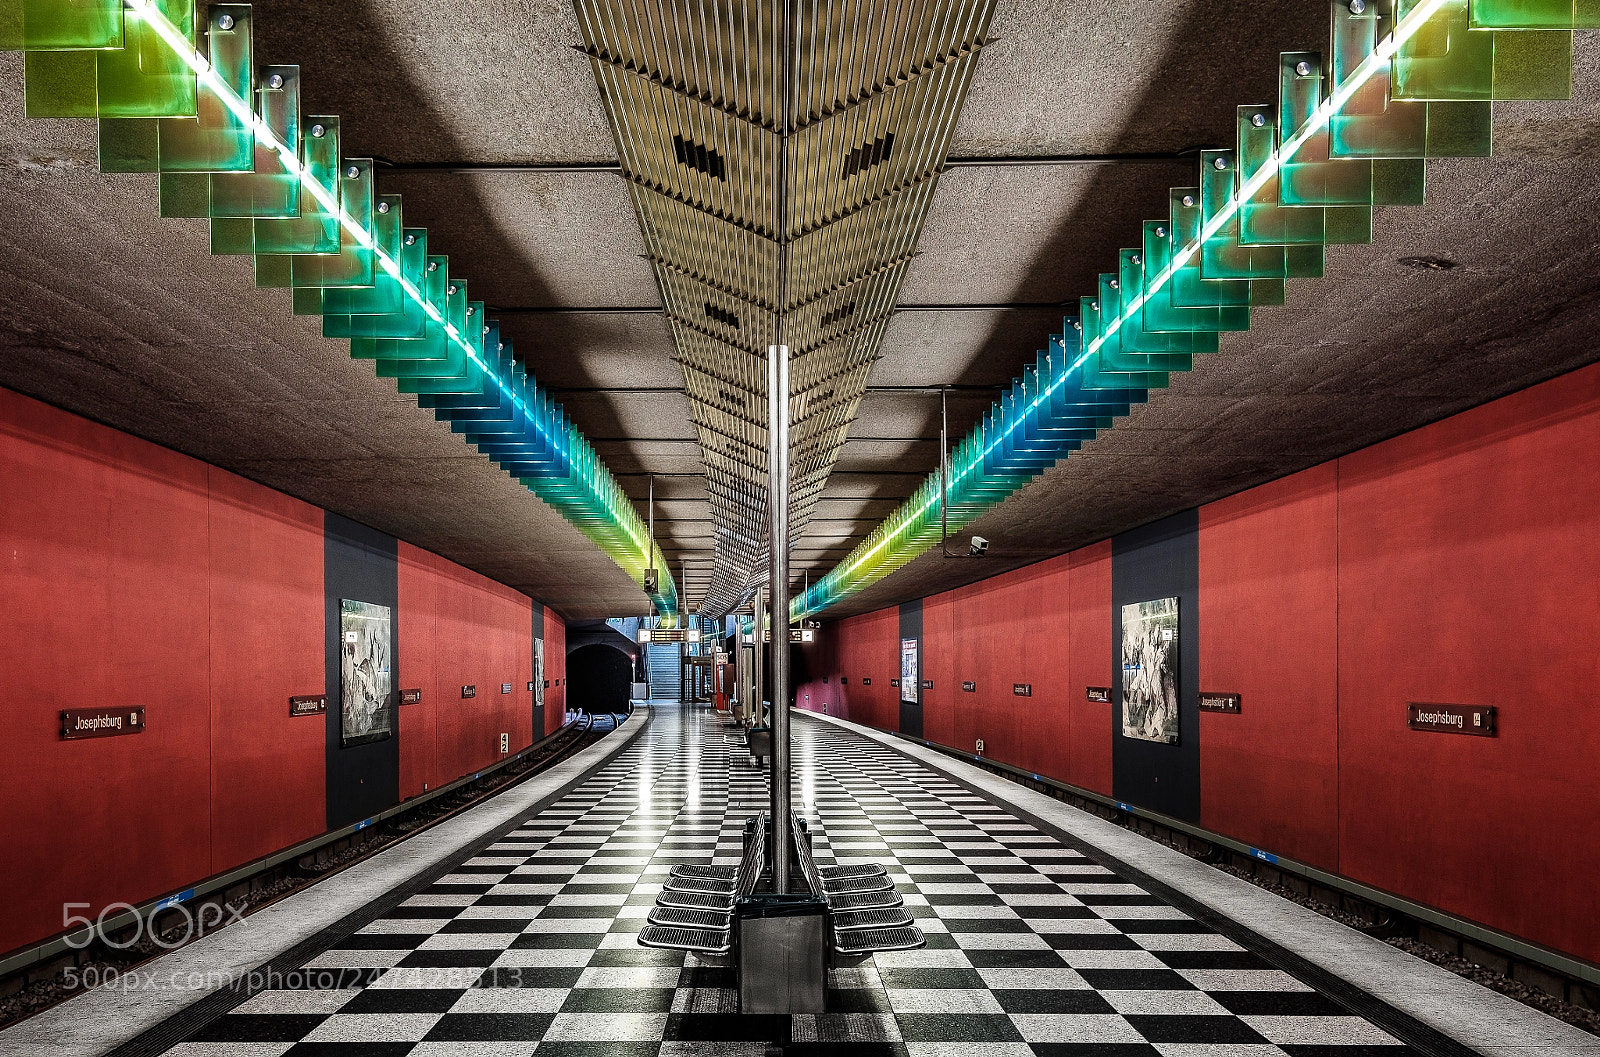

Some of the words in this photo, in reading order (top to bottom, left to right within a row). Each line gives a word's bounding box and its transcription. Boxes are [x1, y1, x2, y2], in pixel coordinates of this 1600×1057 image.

[75, 714, 122, 732] Josephsburg
[1416, 709, 1463, 728] Josephsburg
[501, 734, 507, 742] 4
[501, 743, 507, 752] 2
[977, 741, 982, 750] 2
